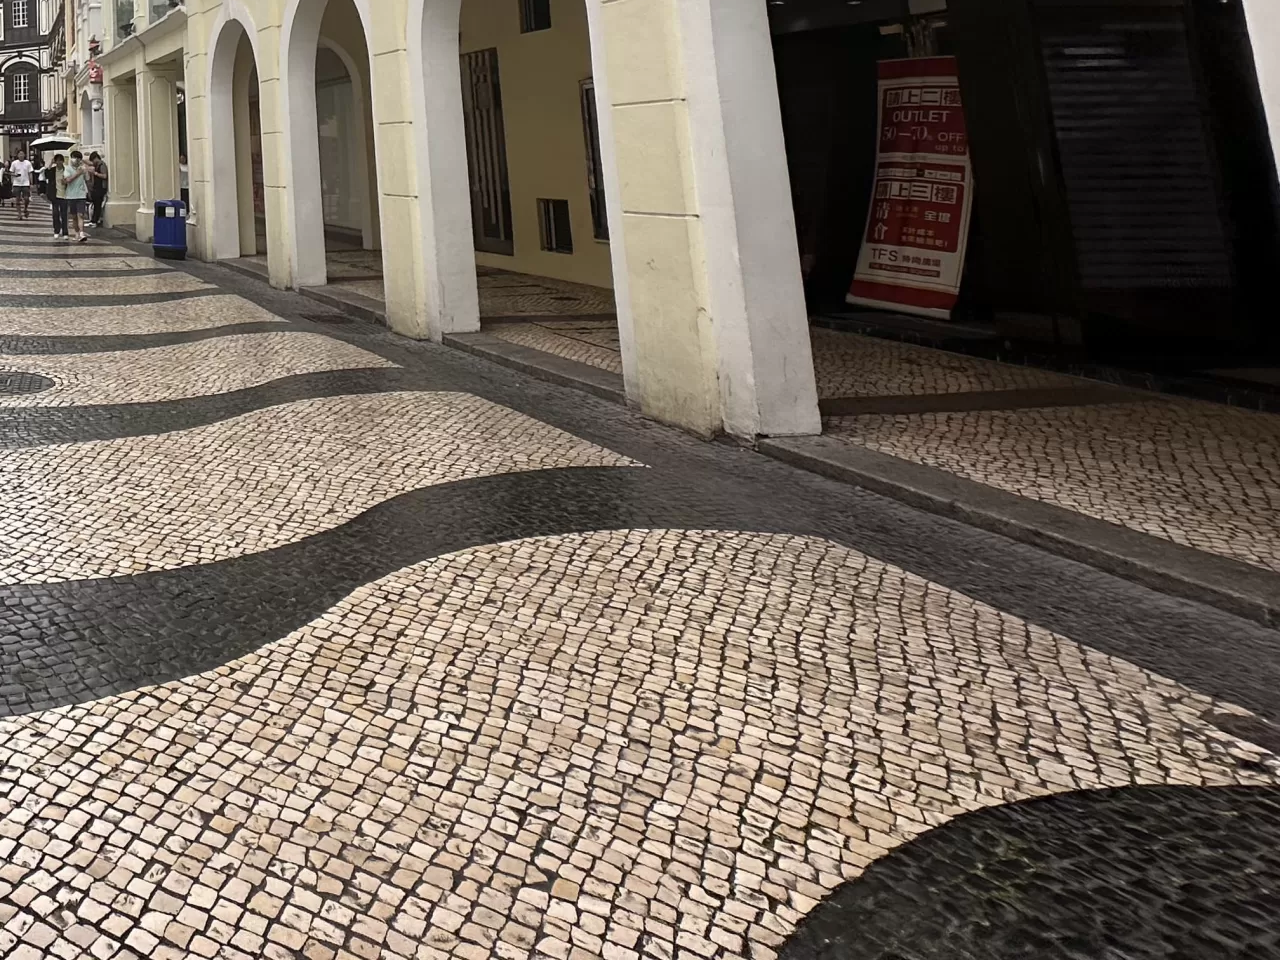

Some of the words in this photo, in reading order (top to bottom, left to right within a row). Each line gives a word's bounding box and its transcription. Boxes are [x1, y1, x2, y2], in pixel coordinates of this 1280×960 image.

[893, 110, 951, 124] OUTLET
[938, 132, 964, 143] OFF
[935, 144, 948, 152] up
[952, 143, 964, 153] to
[871, 248, 898, 262] TFS
